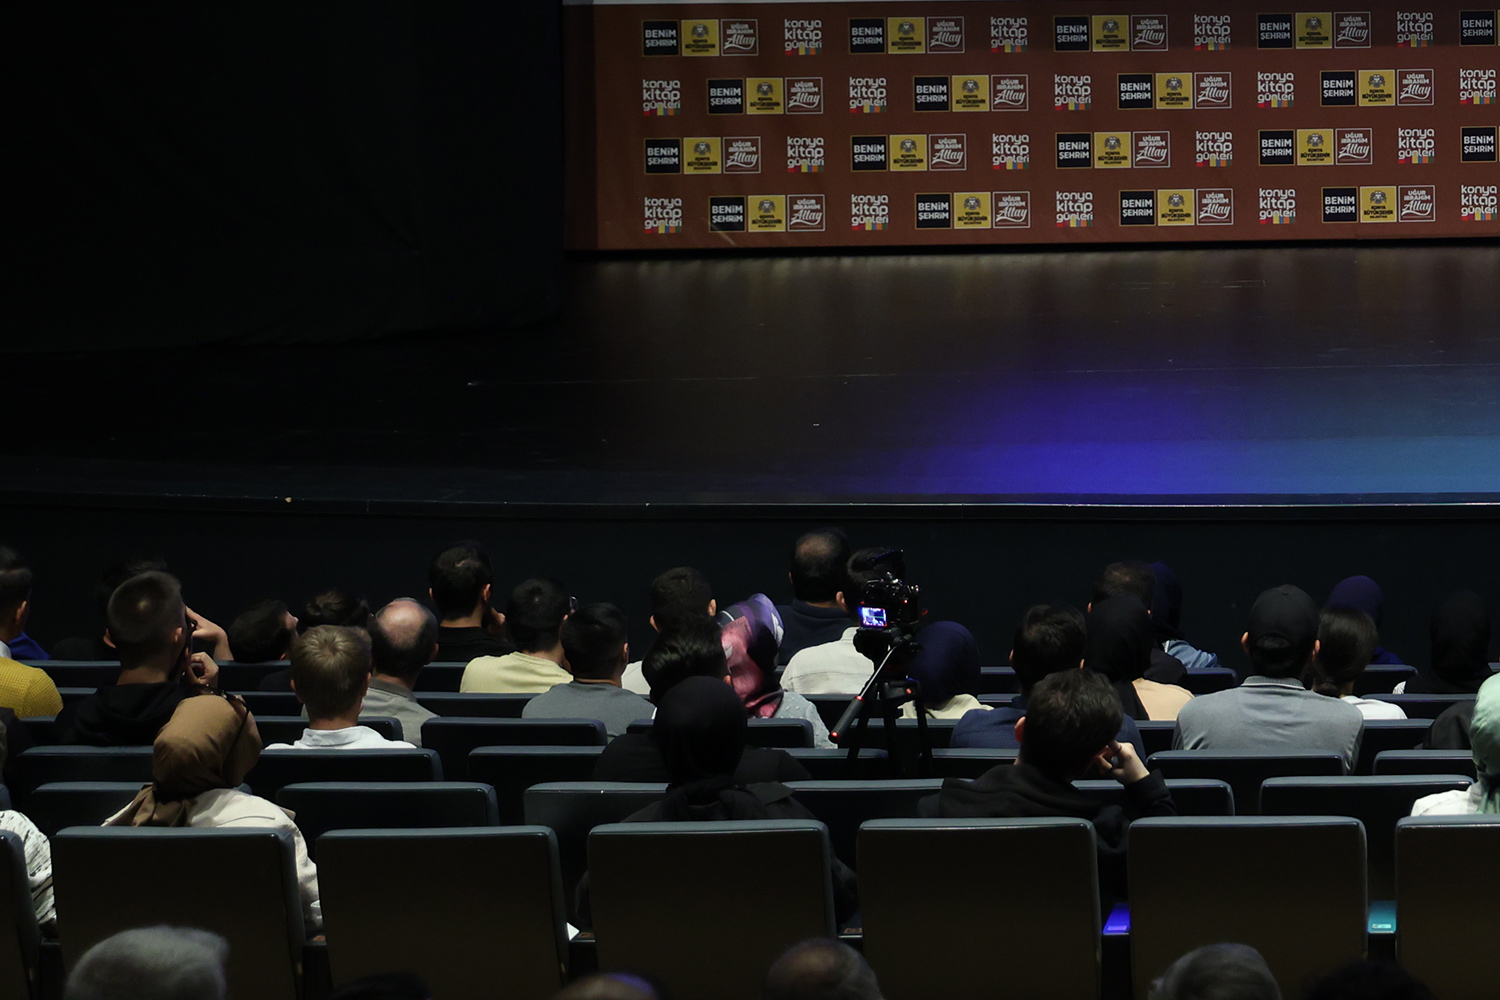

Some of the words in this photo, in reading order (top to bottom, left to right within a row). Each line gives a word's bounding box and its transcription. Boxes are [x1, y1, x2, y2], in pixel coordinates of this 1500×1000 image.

[785, 18, 823, 30] konya
[785, 29, 823, 40] kitap
[1258, 71, 1295, 83] konya
[1258, 82, 1295, 93] kitap
[1057, 191, 1093, 202] konya
[645, 197, 682, 209] konya
[1057, 201, 1093, 212] kitap
[645, 208, 682, 219] kitap
